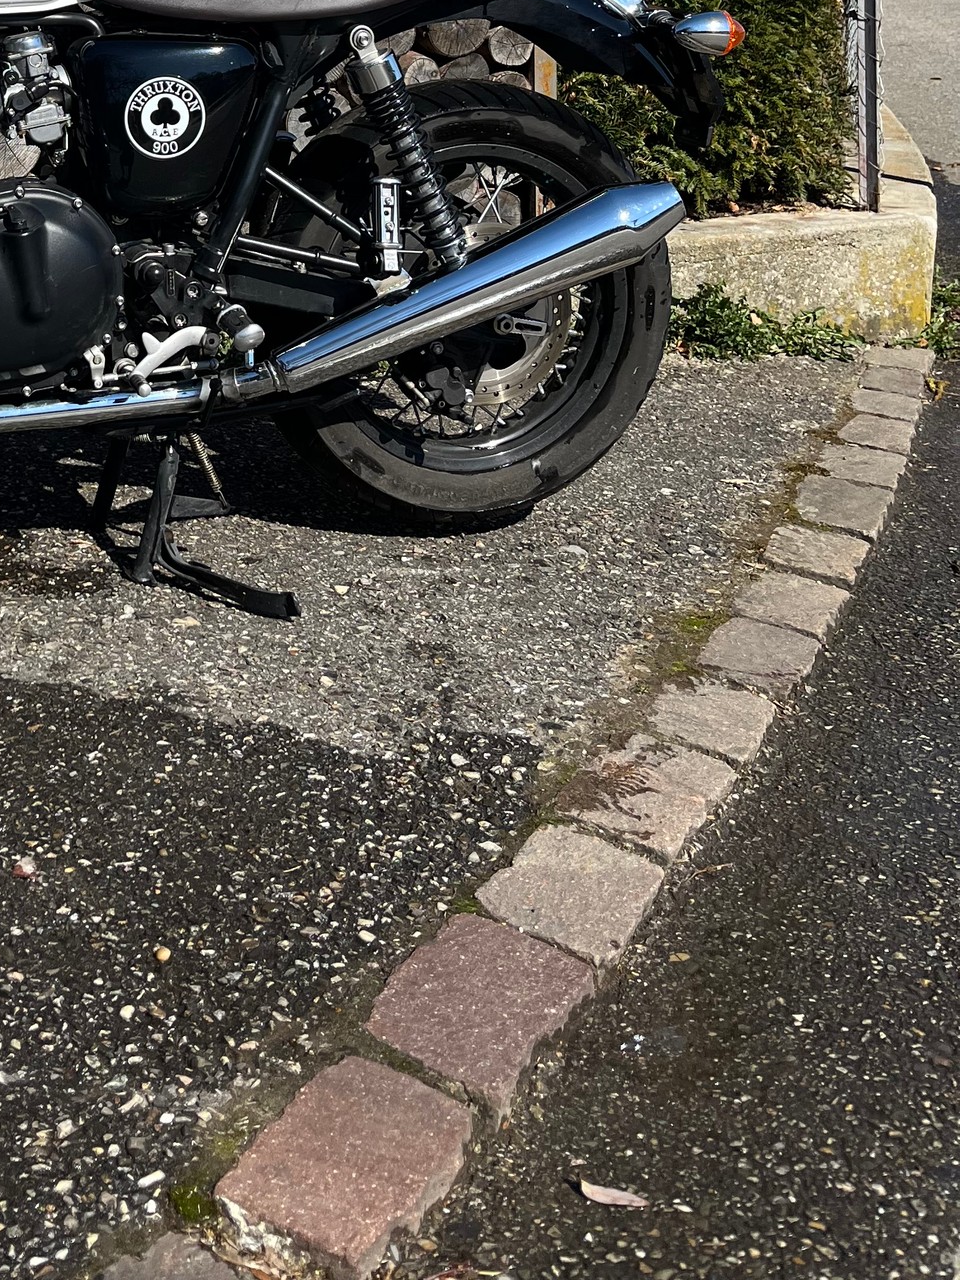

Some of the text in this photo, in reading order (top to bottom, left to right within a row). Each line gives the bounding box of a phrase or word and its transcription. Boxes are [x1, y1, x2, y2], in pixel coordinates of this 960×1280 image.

[129, 80, 201, 112] THRUXTON
[151, 127, 179, 137] ACE
[152, 140, 179, 154] 900
